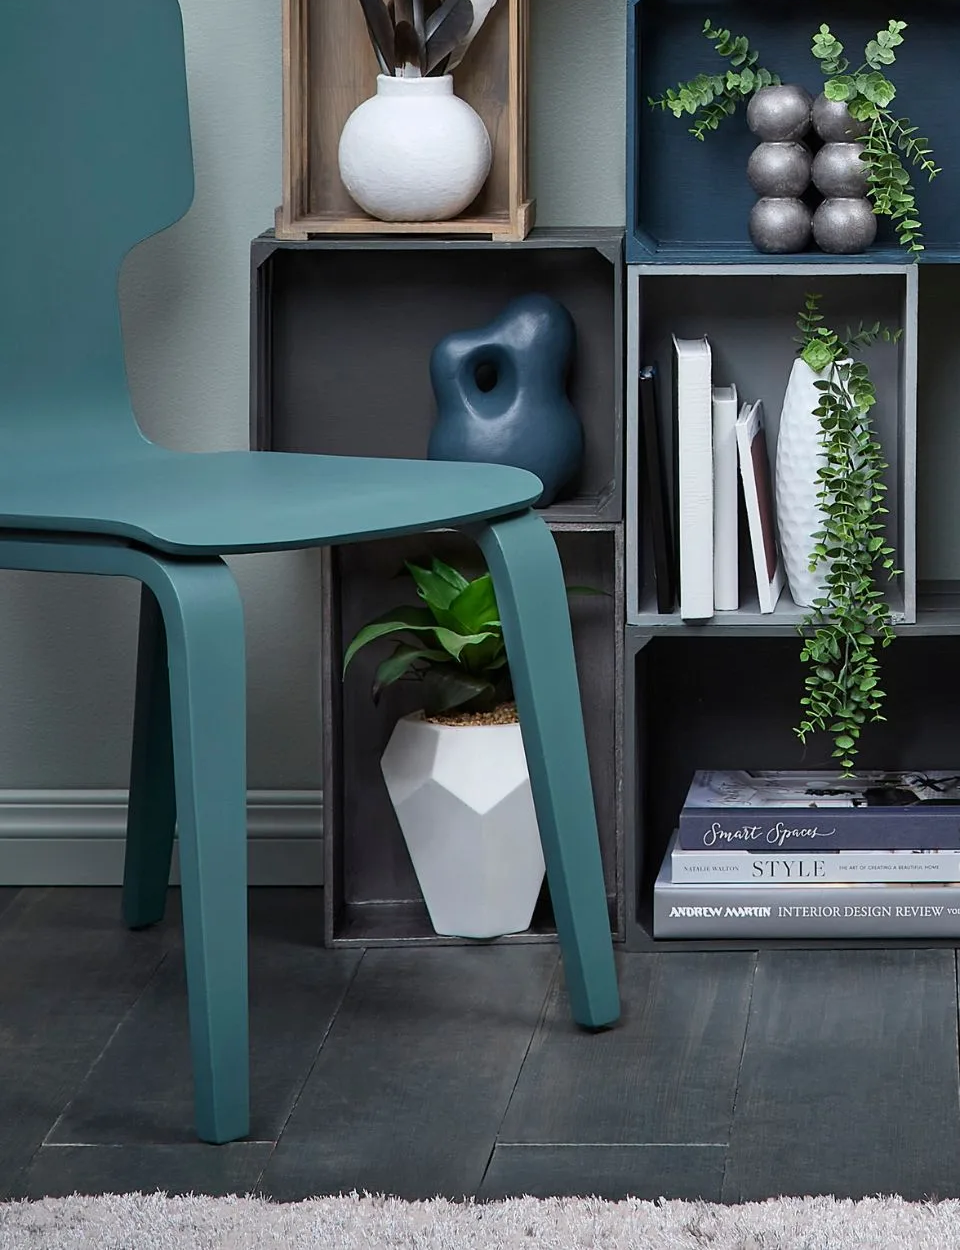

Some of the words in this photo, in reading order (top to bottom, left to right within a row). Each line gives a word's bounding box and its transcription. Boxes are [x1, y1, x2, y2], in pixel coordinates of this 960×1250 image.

[703, 822, 763, 846] Smart
[766, 822, 836, 846] Spaces
[751, 860, 826, 877] STYLE
[669, 906, 723, 918] ANDREW
[724, 906, 772, 918] MARTIN
[778, 906, 841, 918] INTERIOR
[843, 906, 892, 918] DESIGN
[895, 906, 944, 917] REVIEW
